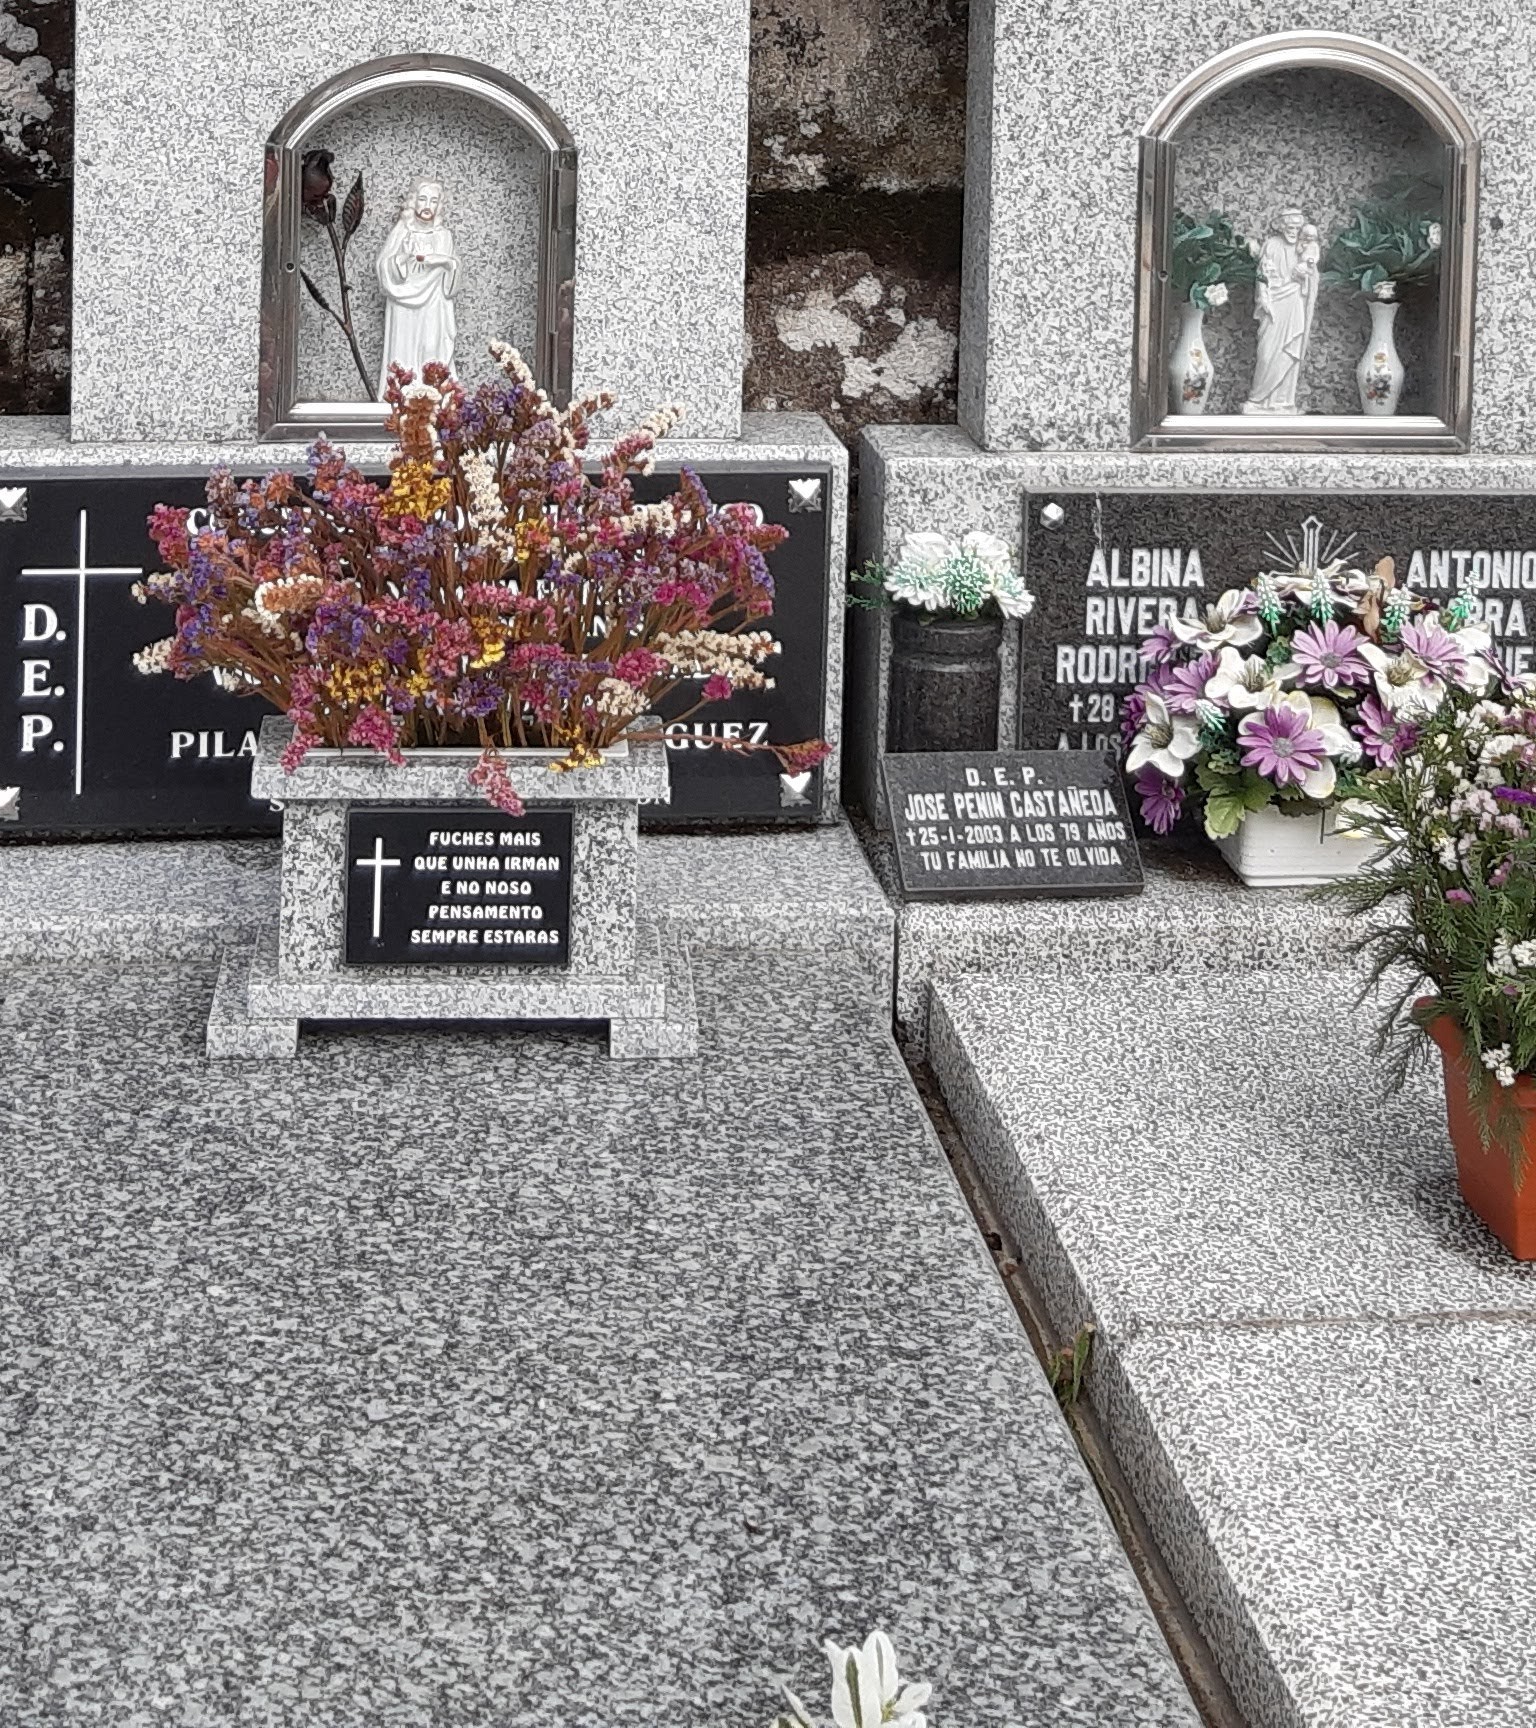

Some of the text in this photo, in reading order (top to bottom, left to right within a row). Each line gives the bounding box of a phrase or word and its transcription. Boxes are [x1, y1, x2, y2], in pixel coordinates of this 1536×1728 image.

[1085, 547, 1206, 588] ALBINA
[20, 603, 67, 753] D. E. P.
[964, 766, 1045, 787] D. E. P.
[904, 785, 1119, 822] JOSE PENIN CASTAÑEDA
[428, 830, 541, 848] FUCHES MAIS
[919, 818, 1127, 847] 25-1-2003 A LOS 79 AÑOS
[413, 855, 561, 872] QUE UNHA IRMAN
[919, 846, 1123, 872] TU FAMILIA NO TE OLVIDA
[440, 880, 533, 896] E NO NOSO
[427, 904, 544, 921] PENSAMENTO
[409, 928, 560, 945] SEMPRE ESTARAS
